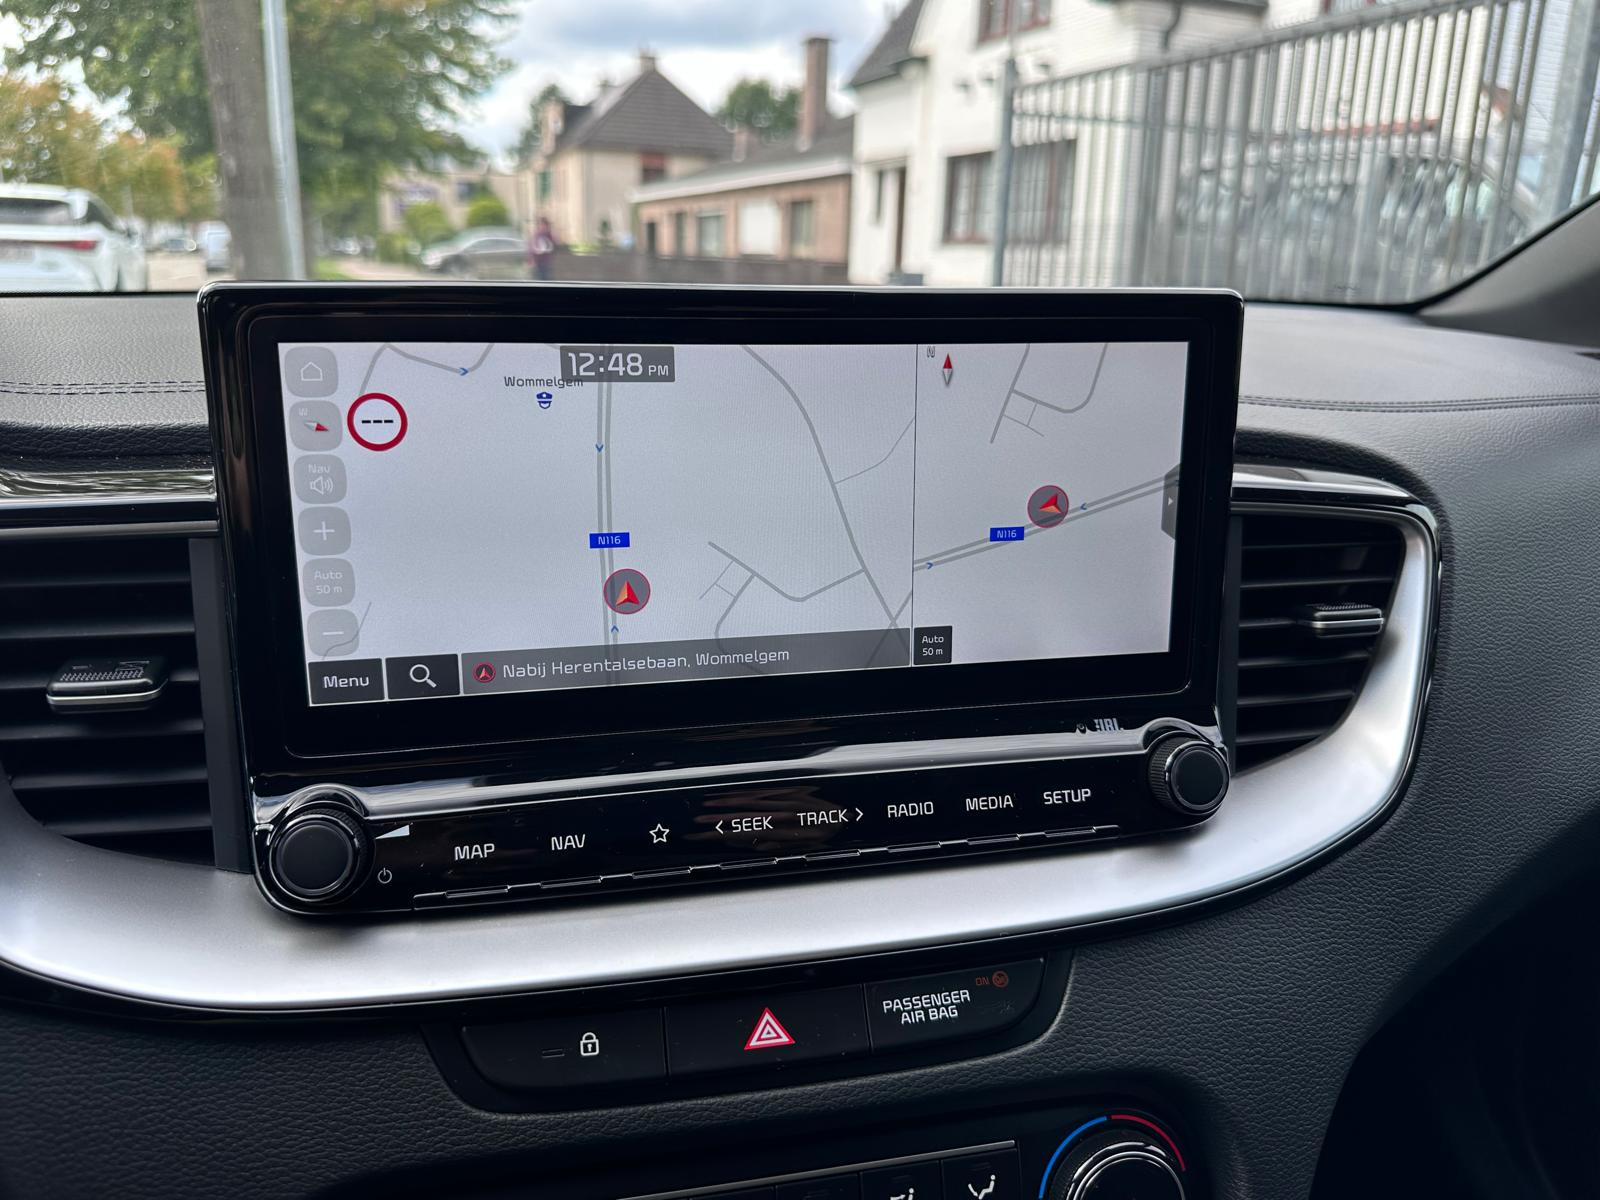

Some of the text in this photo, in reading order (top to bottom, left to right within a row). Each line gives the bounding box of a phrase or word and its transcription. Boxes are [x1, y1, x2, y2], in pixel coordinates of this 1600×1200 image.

[567, 352, 669, 376] 12:48 PM
[504, 376, 584, 388] Wommelgem
[307, 463, 331, 474] Nav
[597, 535, 621, 546] N116
[996, 529, 1017, 540] N116
[313, 569, 343, 581] Auto
[315, 584, 343, 595] 50 m
[921, 634, 944, 645] Auto
[922, 647, 943, 656] 50 m
[502, 648, 790, 679] Nabij Herentalsebaan, Wommelgem
[323, 674, 370, 690] Menu
[965, 794, 1014, 812] MEDIA
[1043, 788, 1092, 806] SETUP
[797, 808, 849, 827] TRACK
[887, 801, 934, 819] RADIO
[731, 815, 774, 833] SEEK
[550, 834, 587, 851] NAV
[454, 843, 496, 861] MAP
[882, 989, 971, 1013] PASSENGER
[901, 1005, 959, 1025] AIR BAG
